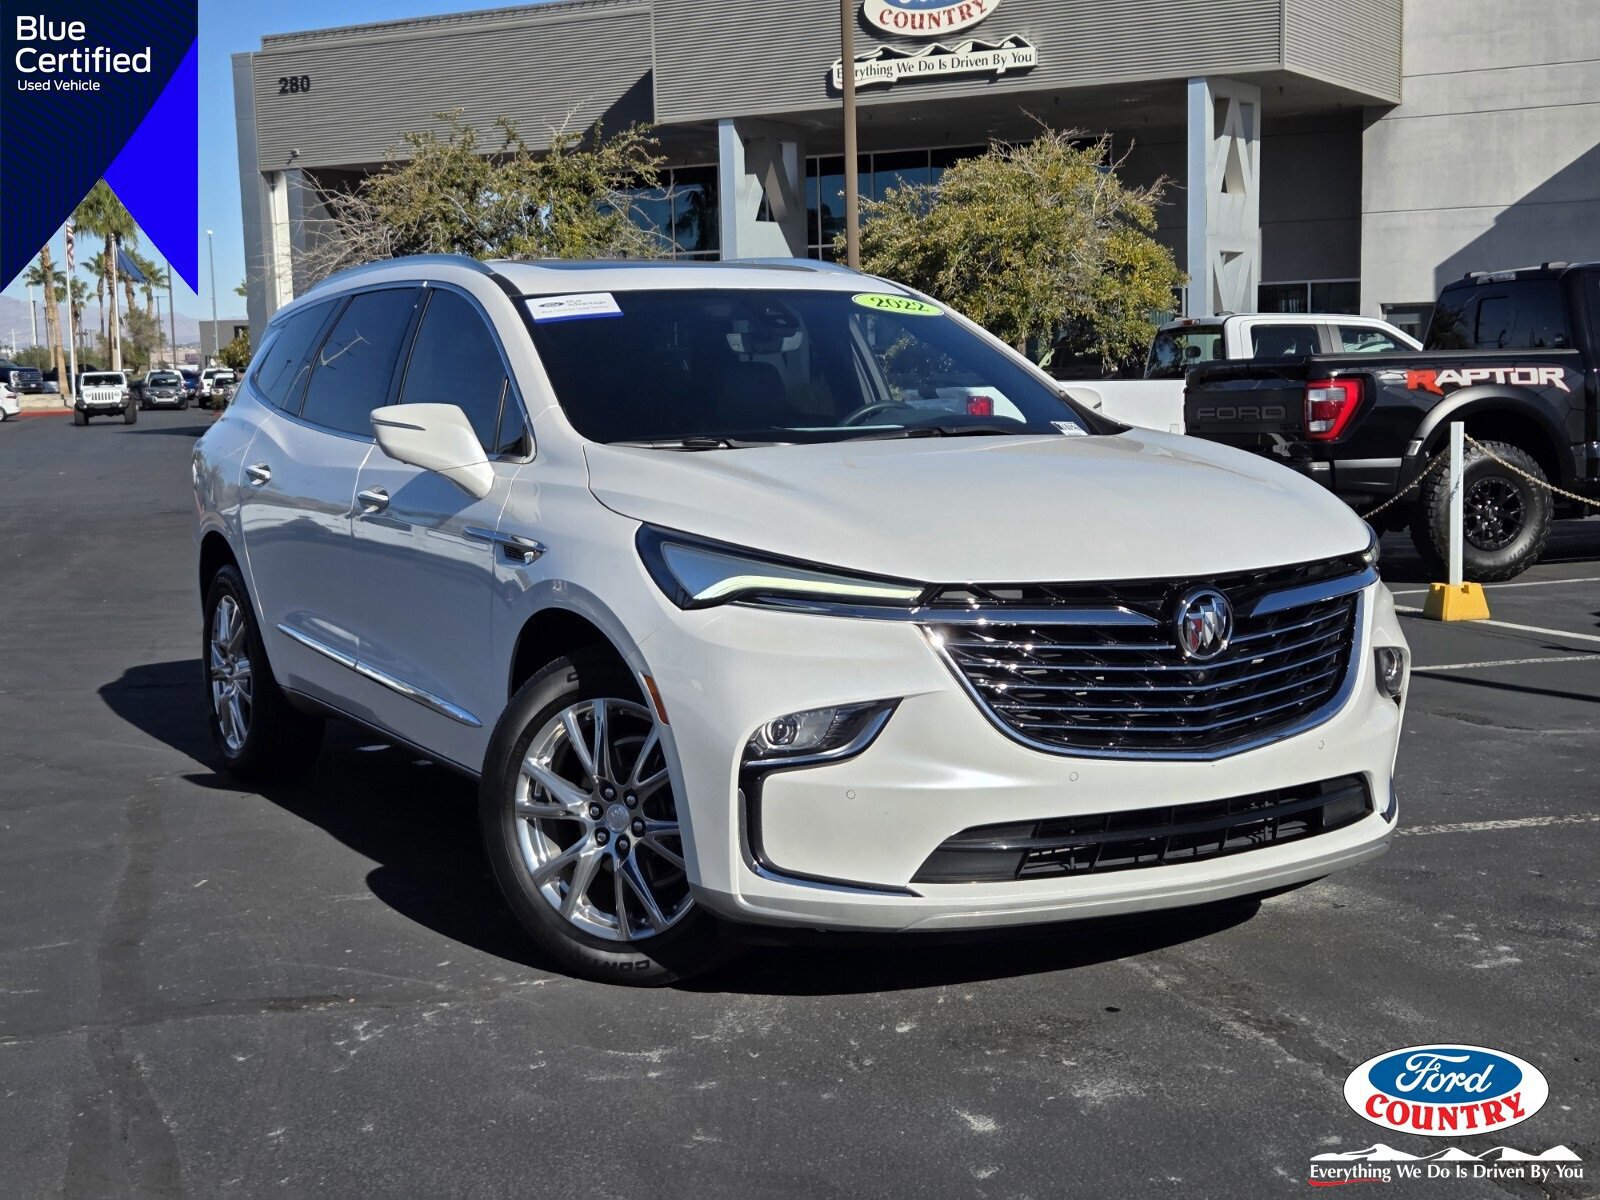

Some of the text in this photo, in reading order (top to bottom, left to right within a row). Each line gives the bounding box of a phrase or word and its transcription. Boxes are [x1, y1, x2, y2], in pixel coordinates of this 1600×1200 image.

[879, 0, 987, 30] COUNTRY
[837, 52, 1032, 80] Erything We Do Is Driven By You
[278, 75, 311, 95] 280
[870, 297, 930, 312] 2022
[1407, 367, 1571, 396] RAPTOR
[1197, 405, 1287, 421] FORD
